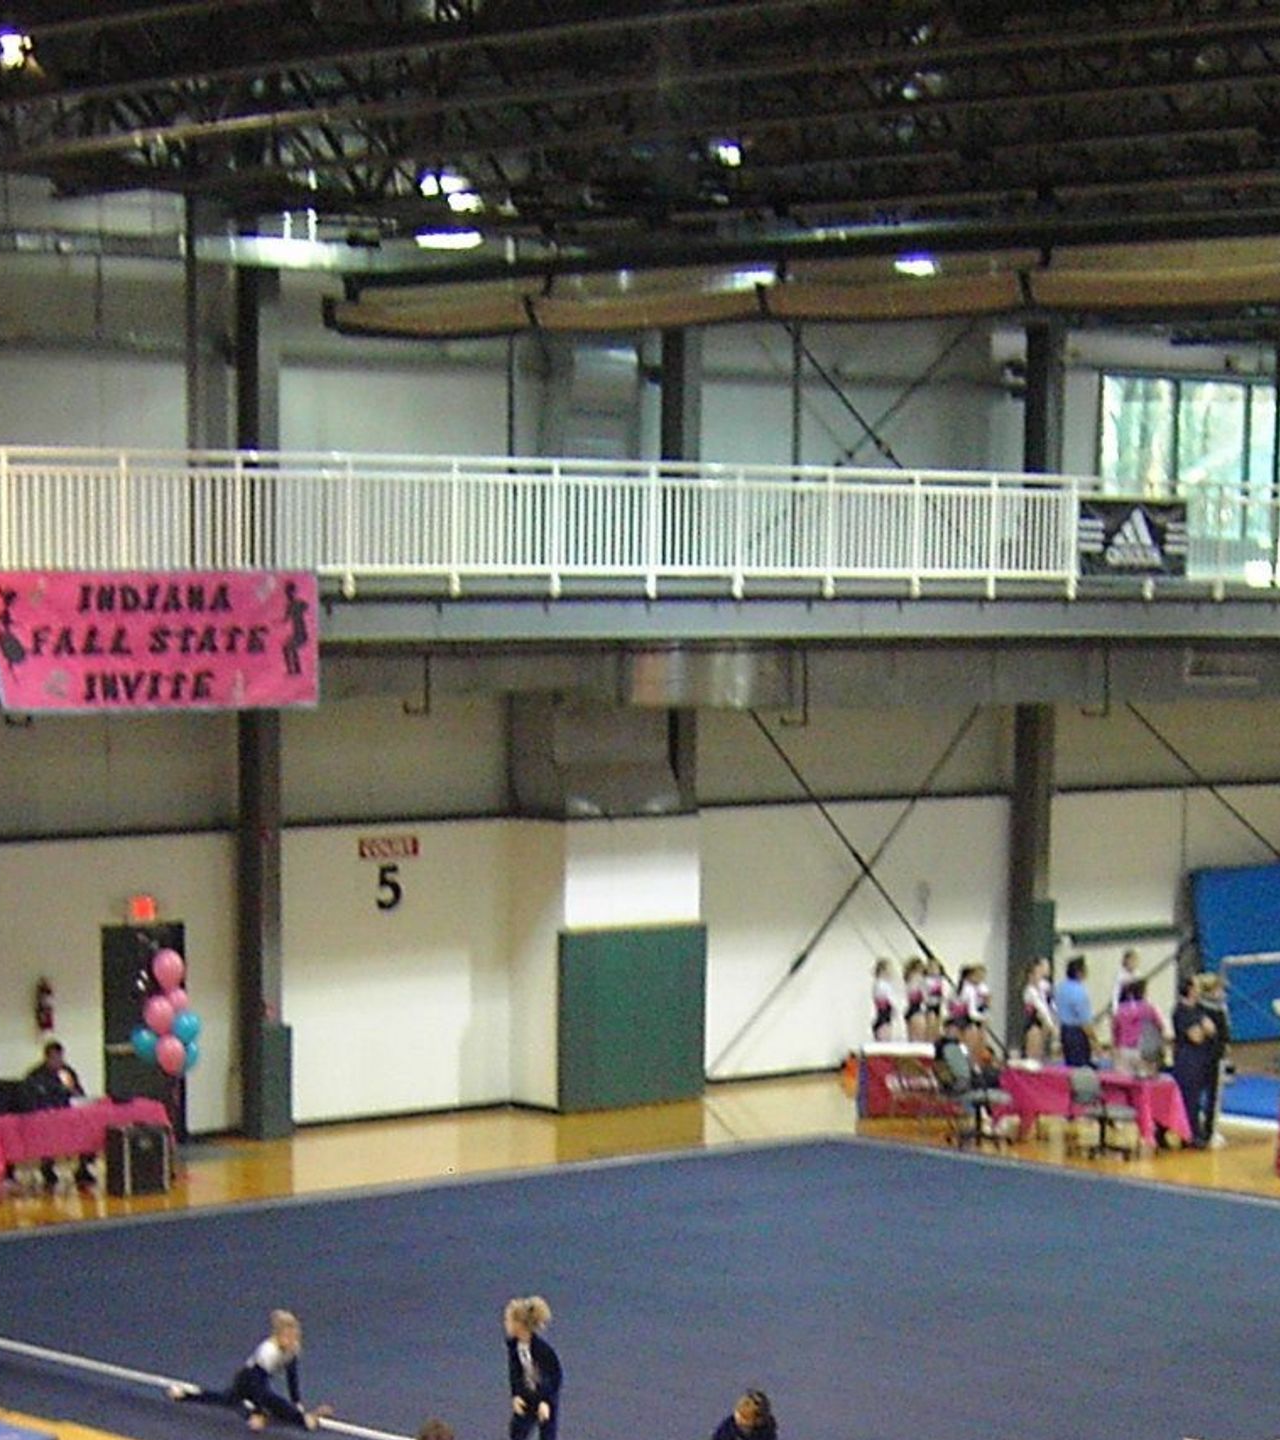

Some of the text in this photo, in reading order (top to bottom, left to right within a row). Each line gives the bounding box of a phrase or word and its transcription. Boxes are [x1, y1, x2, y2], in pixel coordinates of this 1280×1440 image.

[77, 583, 233, 614] INDIANA
[32, 625, 268, 656] FALL STATE
[83, 671, 216, 702] INVITE
[376, 863, 402, 910] 5
